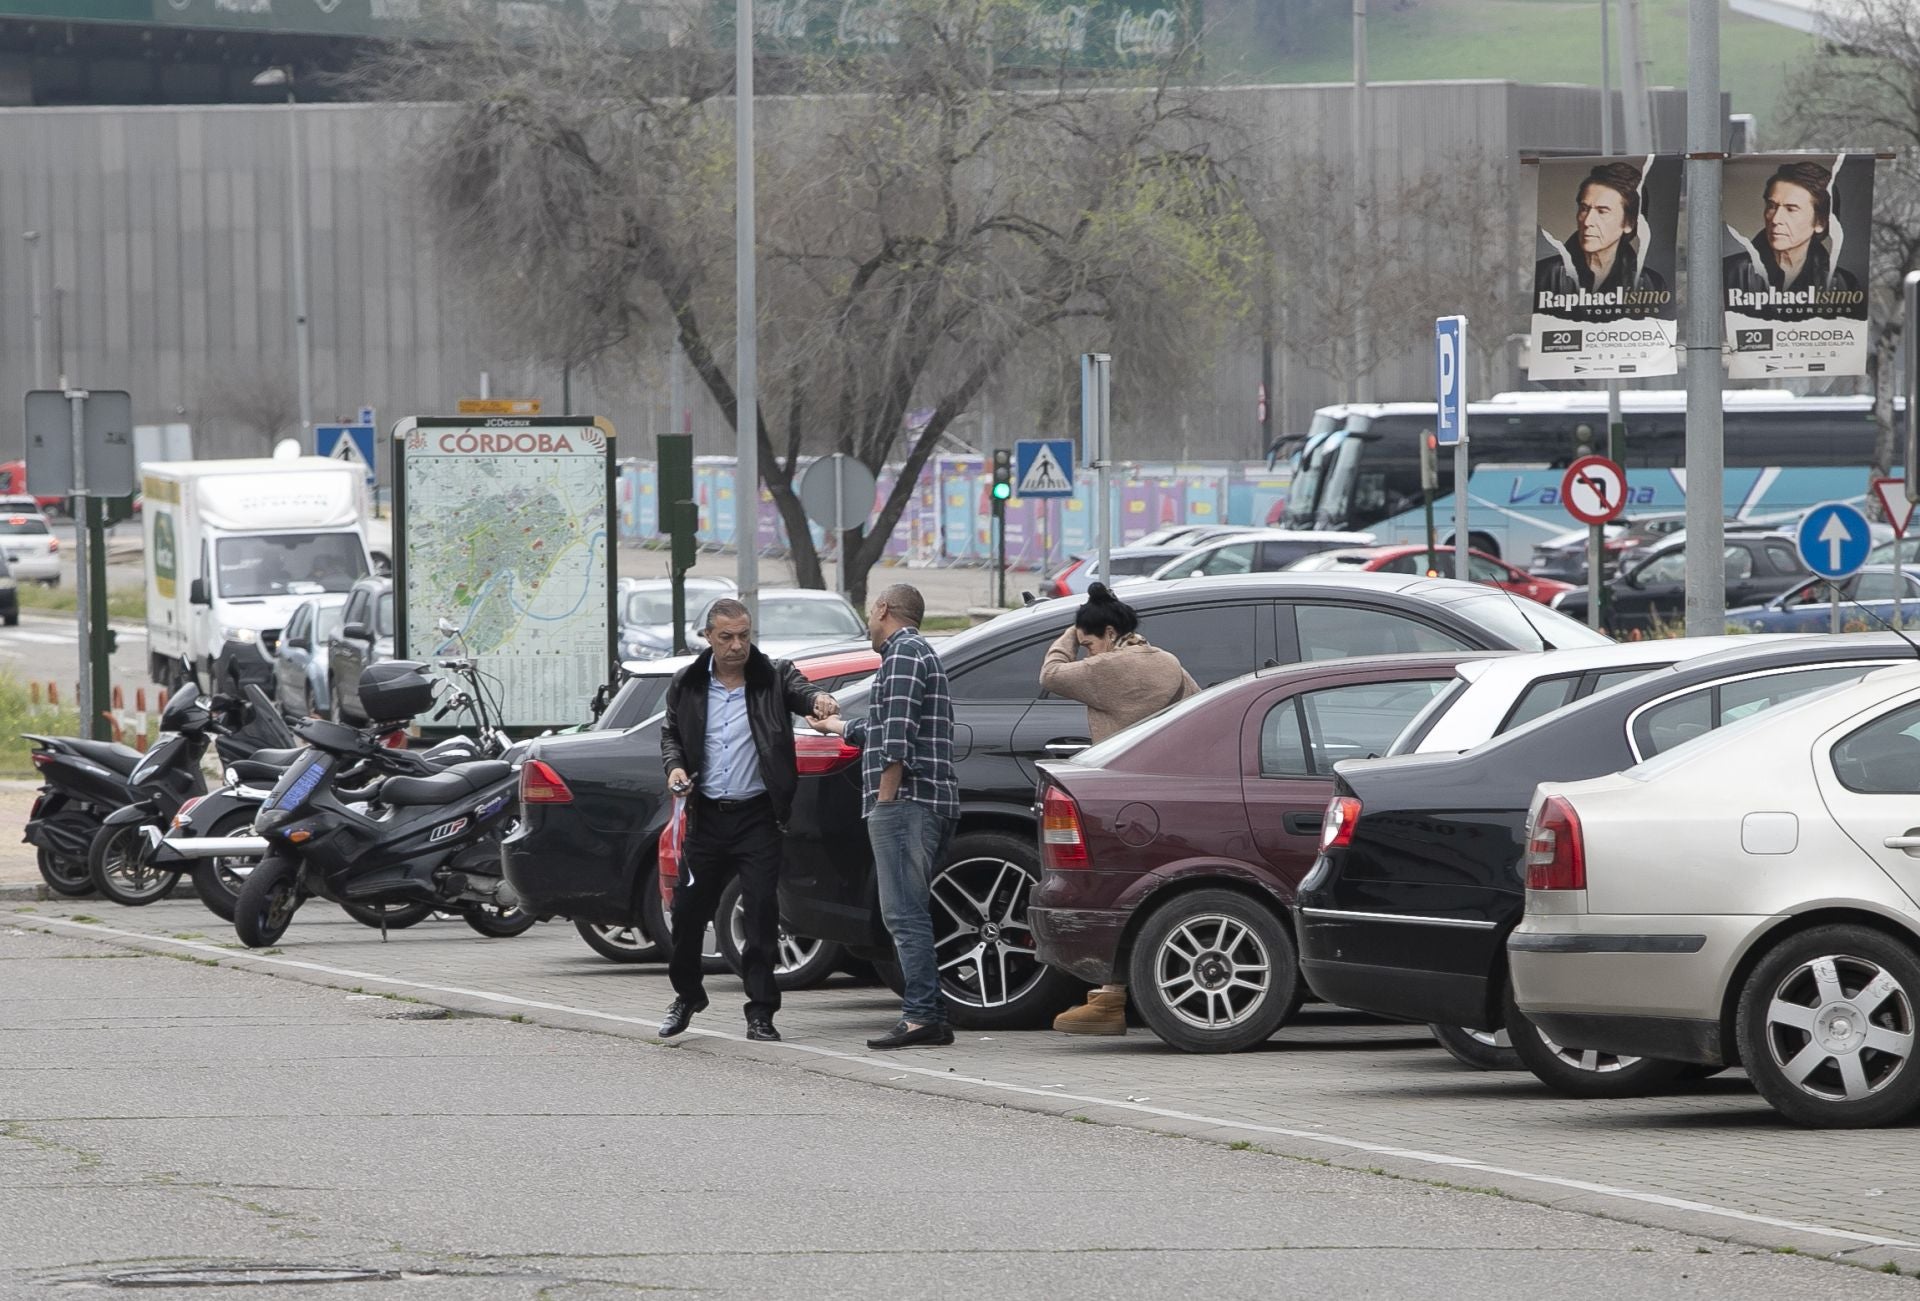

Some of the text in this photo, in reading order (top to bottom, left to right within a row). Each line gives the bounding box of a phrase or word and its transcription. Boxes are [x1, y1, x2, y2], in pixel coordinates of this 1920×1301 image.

[1539, 286, 1671, 311] Raphaelísimo
[1728, 285, 1864, 310] Raphaelísimo
[1553, 332, 1571, 344] 20
[1585, 329, 1664, 342] CÓRDOBA
[1745, 331, 1763, 343] 20
[1776, 329, 1854, 341] CÓRDOBA
[484, 418, 530, 428] JCDecaux
[438, 428, 574, 452] CÓRDOBA
